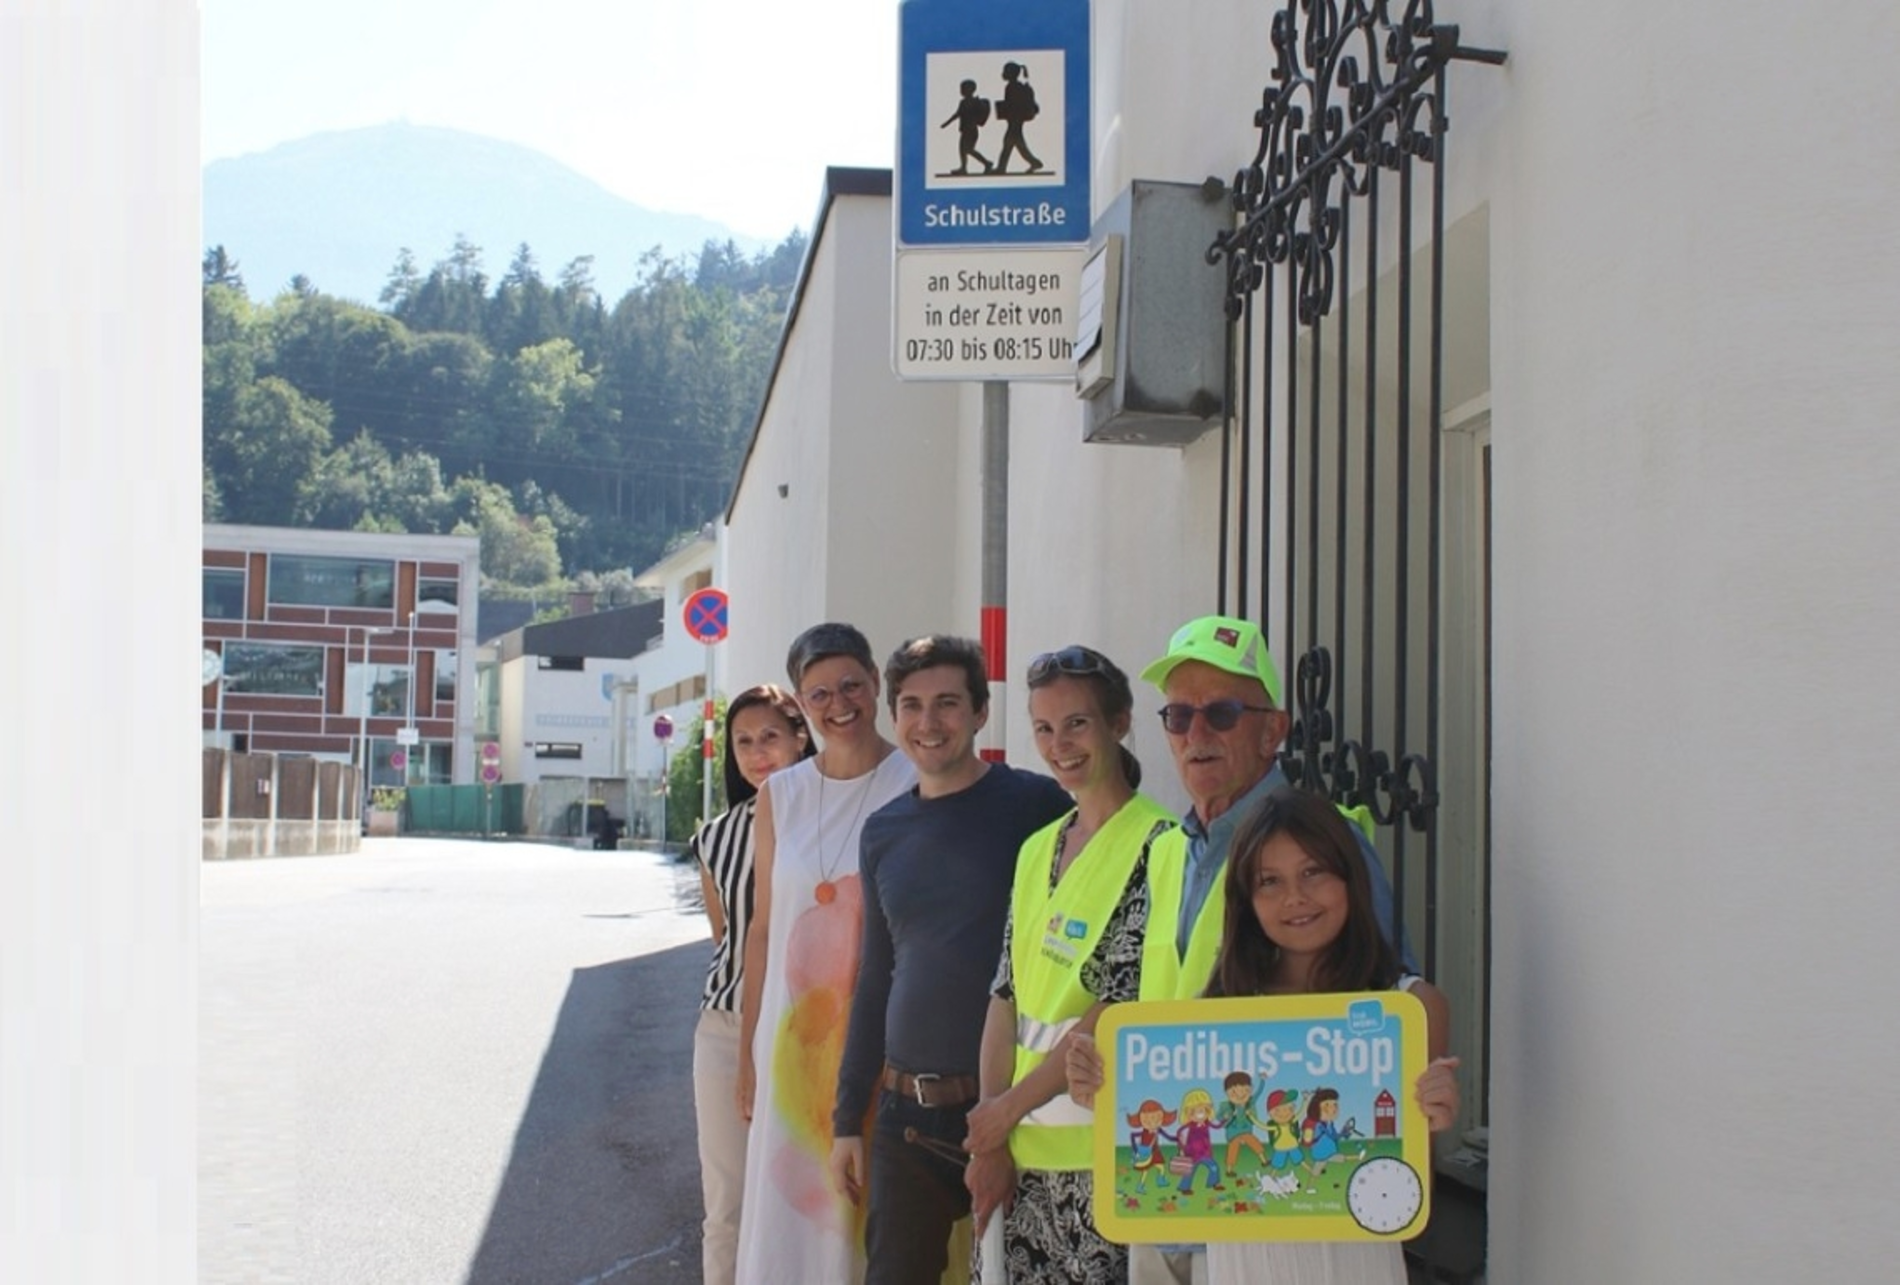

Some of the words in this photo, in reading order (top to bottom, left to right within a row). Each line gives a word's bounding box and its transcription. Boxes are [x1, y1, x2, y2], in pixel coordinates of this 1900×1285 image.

[924, 202, 1066, 227] Schulstraße
[927, 275, 950, 292] an
[957, 269, 1060, 295] Schultagen
[925, 303, 942, 326] in
[949, 304, 980, 326] der
[986, 302, 1022, 326] Zeit
[1028, 306, 1062, 325] von
[906, 339, 954, 362] 07:30
[961, 337, 988, 361] bis
[994, 337, 1042, 361] 08:15
[1126, 1026, 1394, 1087] Pedibus-Stop
